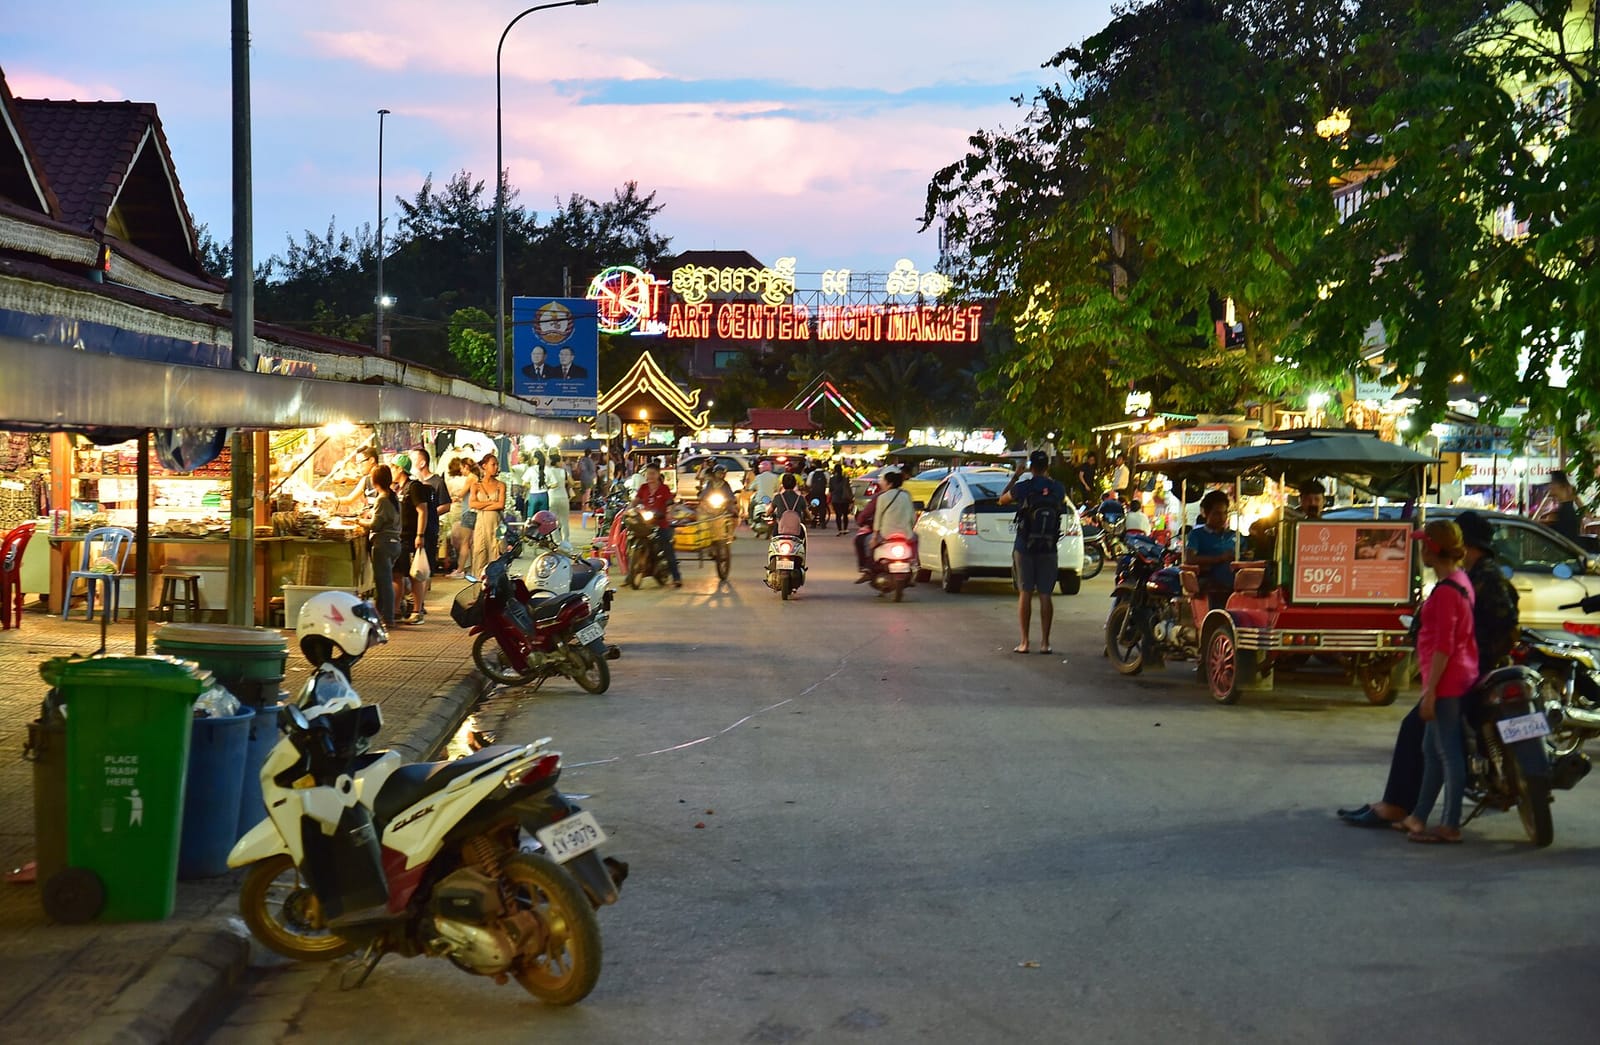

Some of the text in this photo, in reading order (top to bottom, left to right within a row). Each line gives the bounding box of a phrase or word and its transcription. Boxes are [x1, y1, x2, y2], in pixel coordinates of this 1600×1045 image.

[667, 303, 983, 342] ART CENTER NIGHT MARKET
[1303, 567, 1342, 583] 50%
[1310, 583, 1333, 594] OFF
[104, 755, 138, 764] PLACE
[104, 766, 139, 776] TRASH
[106, 777, 135, 787] HERE
[391, 804, 434, 833] CLICK
